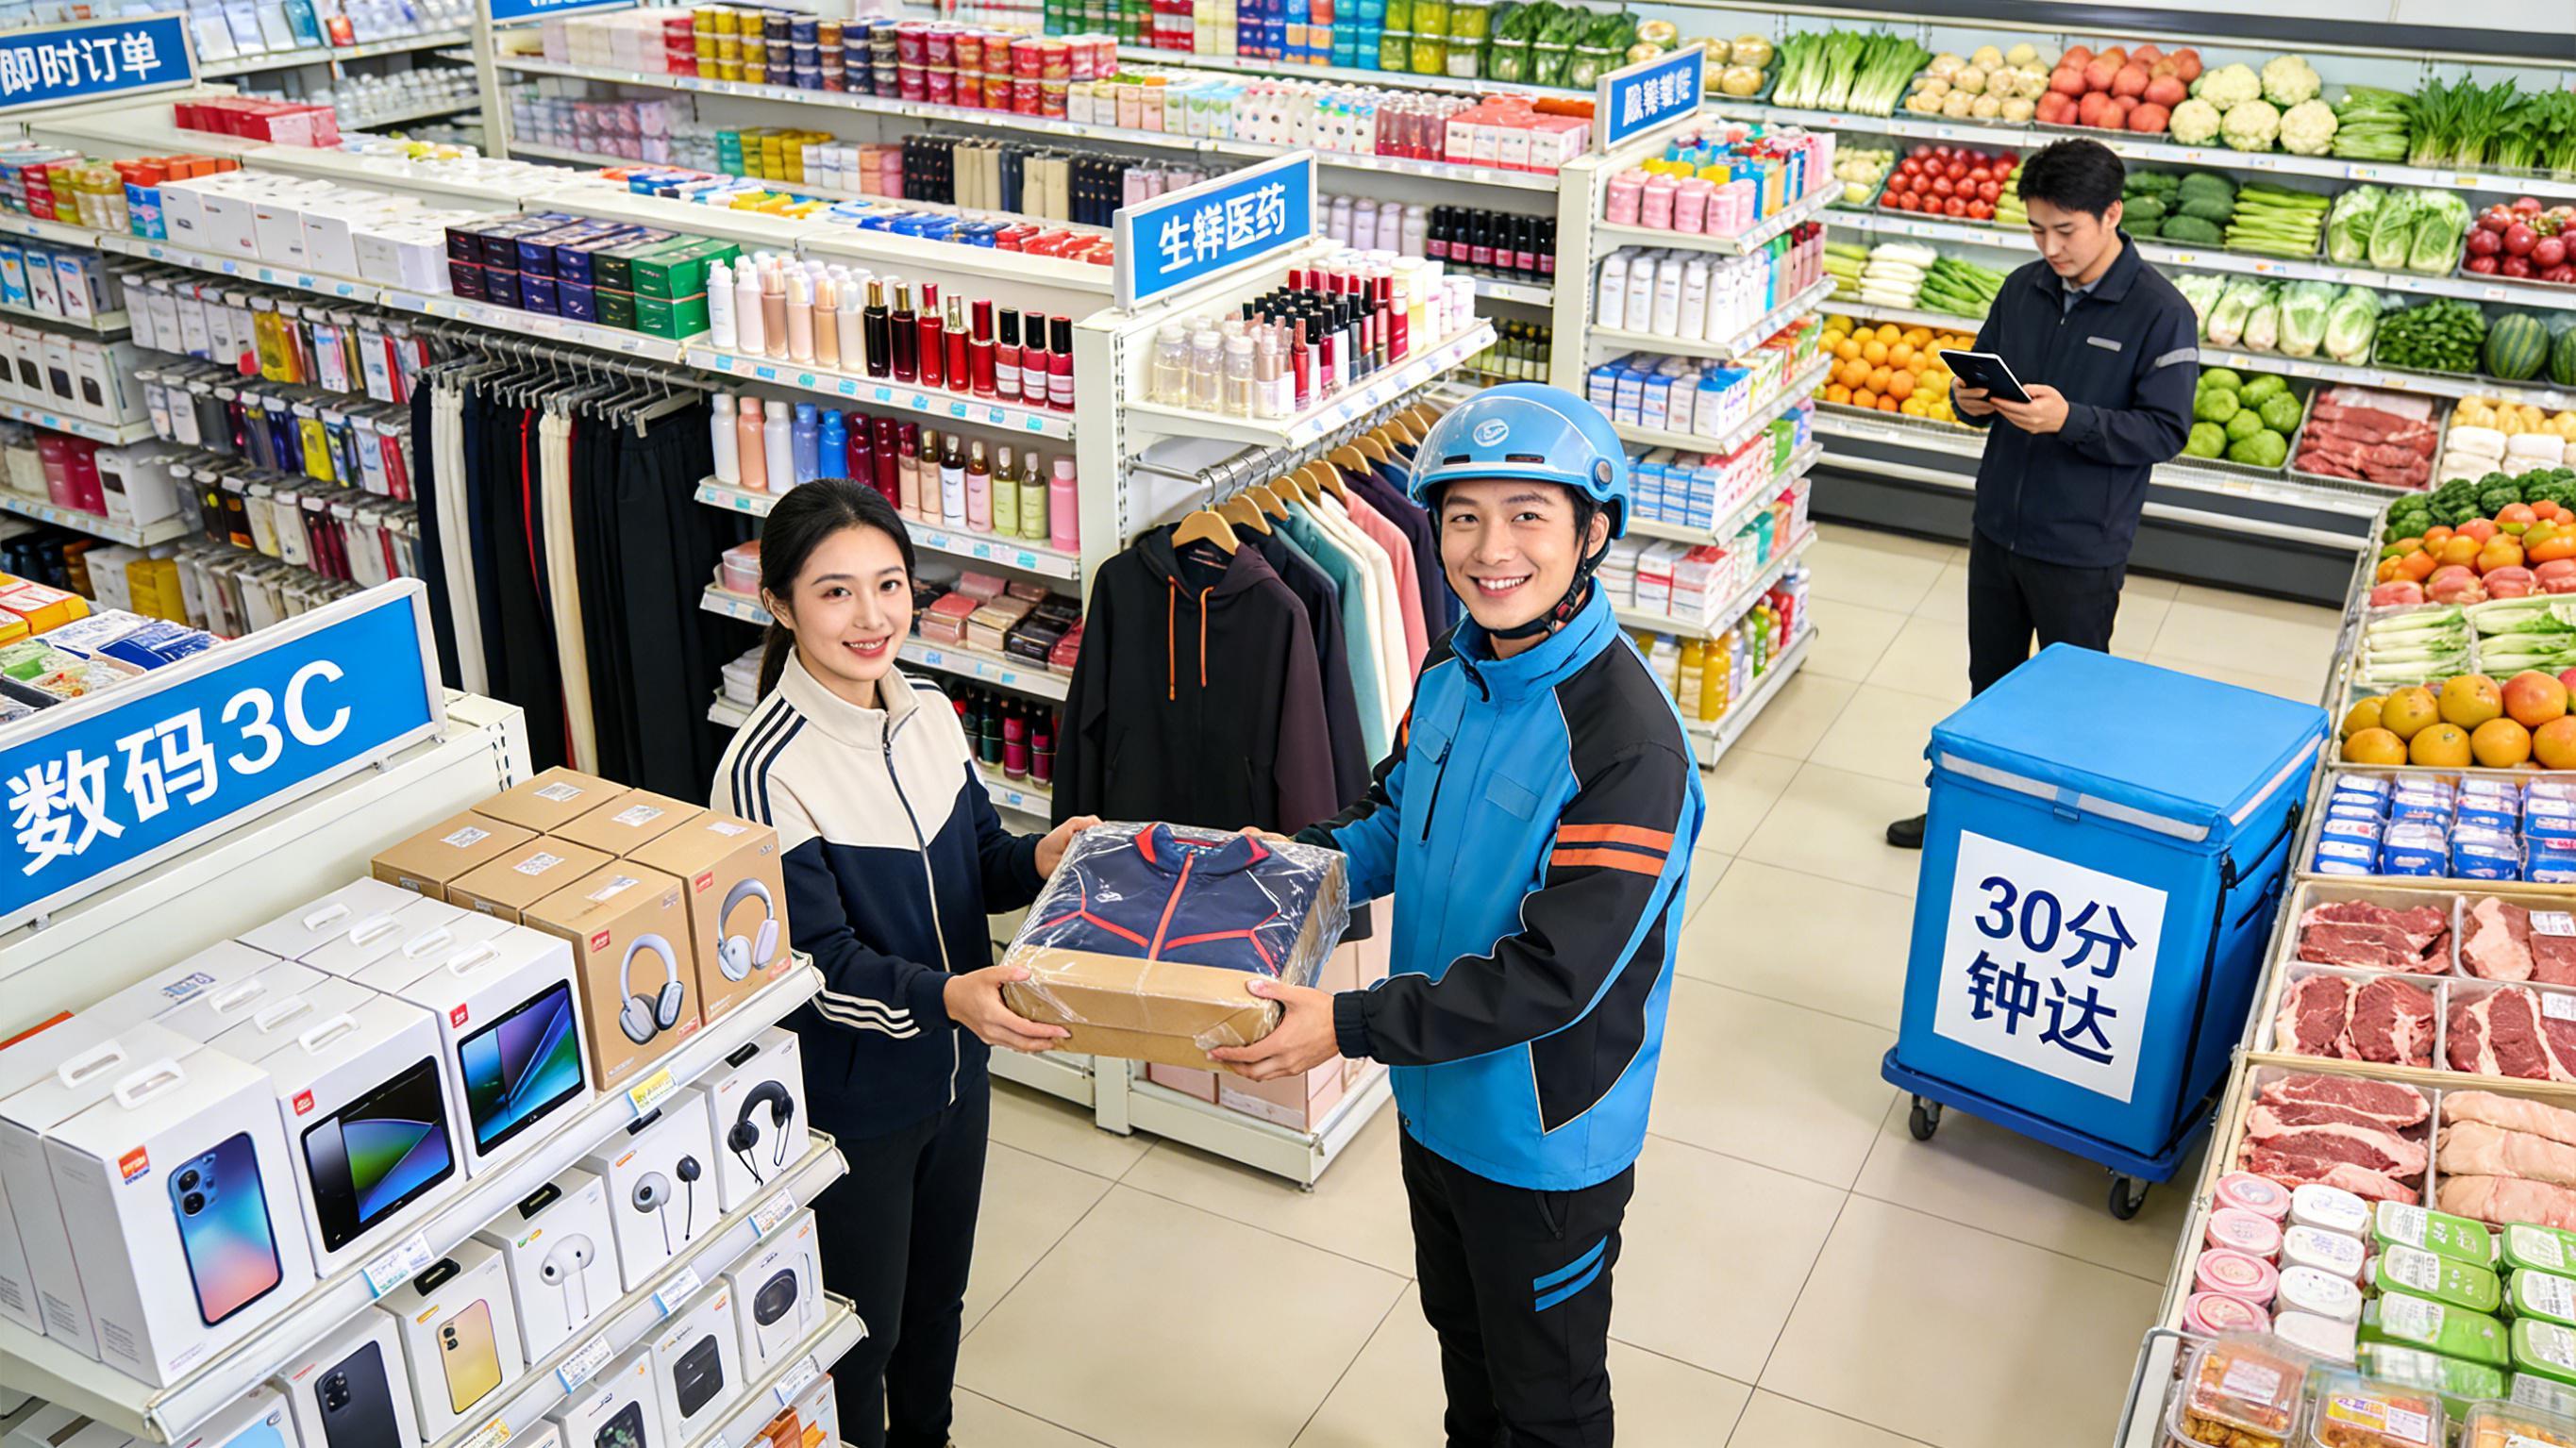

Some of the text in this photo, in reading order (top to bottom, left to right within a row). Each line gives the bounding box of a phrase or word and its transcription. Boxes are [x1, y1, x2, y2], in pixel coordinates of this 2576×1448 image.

[6, 659, 351, 876] 数码3C
[1975, 875, 2137, 978] 30分
[1965, 949, 2116, 1065] 钟达
